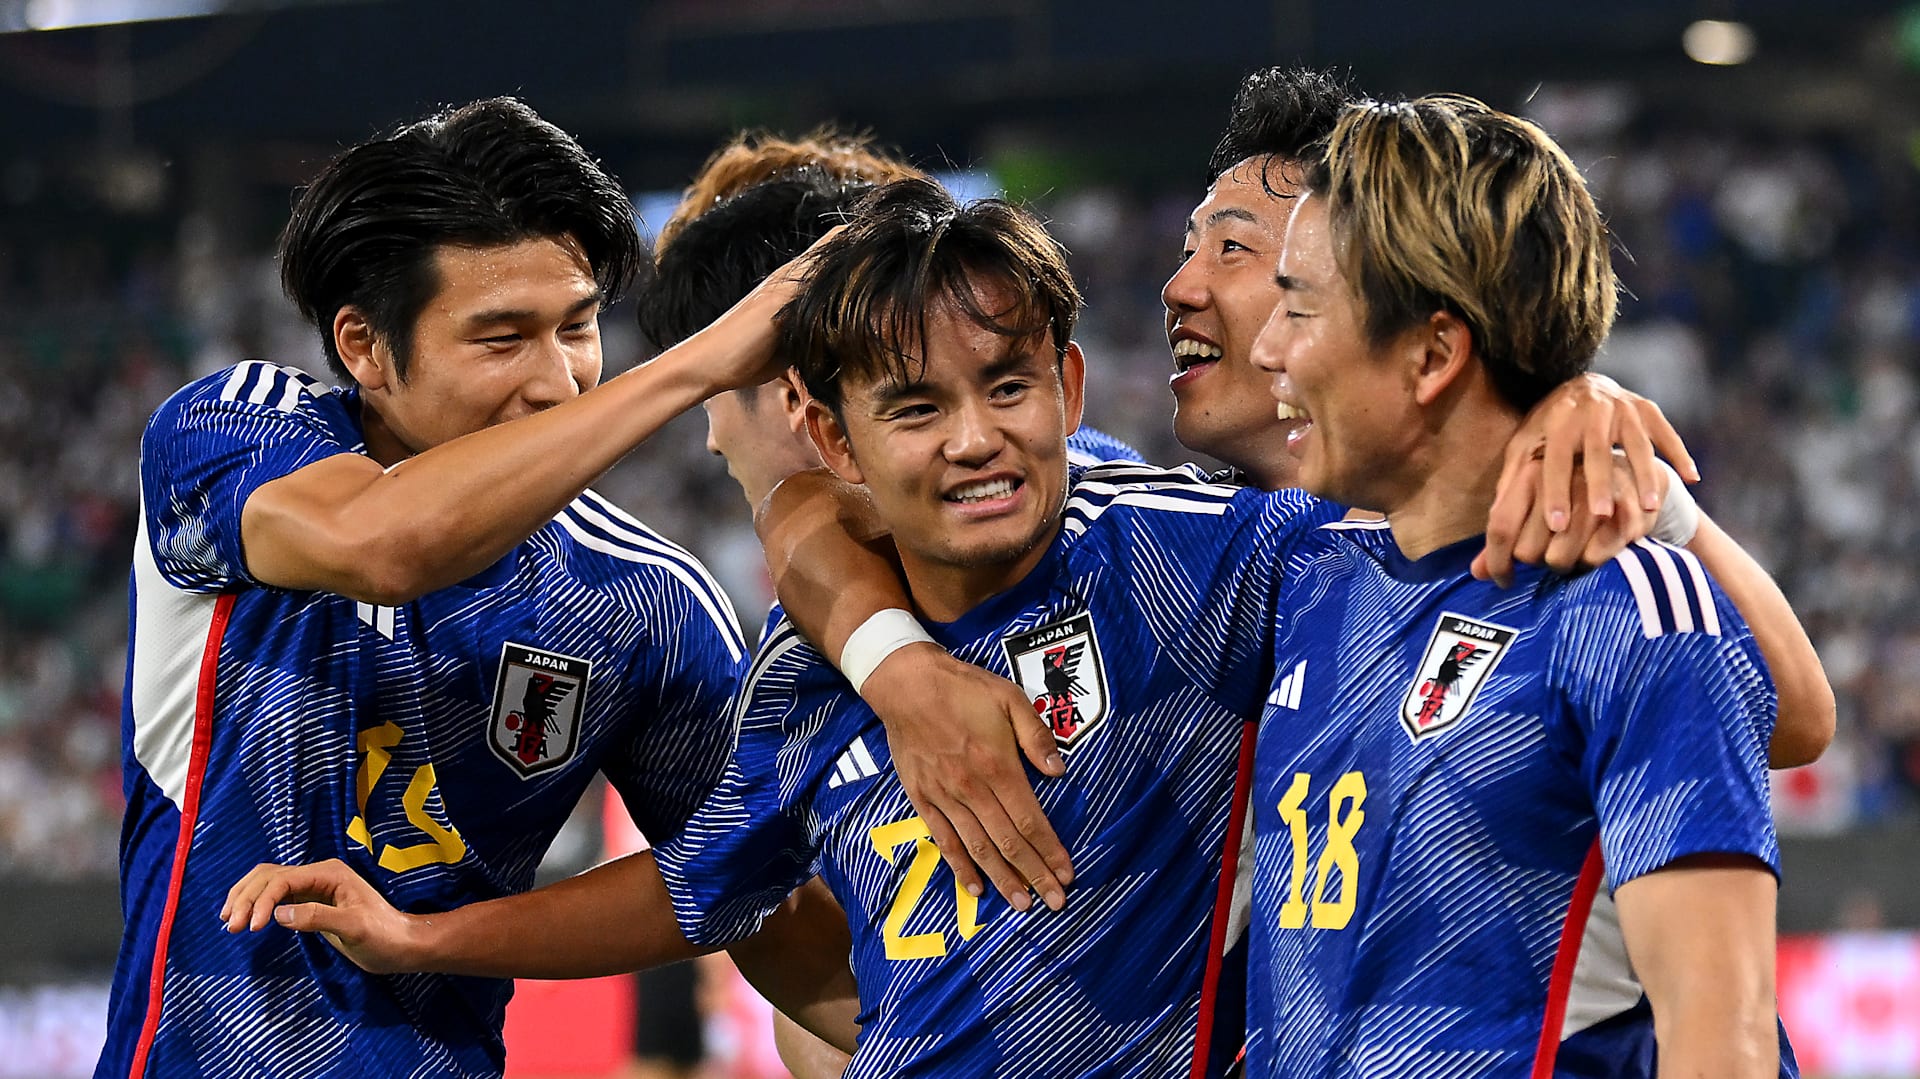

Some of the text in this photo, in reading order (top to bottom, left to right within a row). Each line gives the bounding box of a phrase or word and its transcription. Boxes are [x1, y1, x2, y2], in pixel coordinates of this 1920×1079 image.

[1028, 624, 1074, 647] JAPAN
[1453, 621, 1498, 640] JAPAN
[525, 653, 569, 671] JAPAN
[508, 733, 549, 758] JFA
[1277, 771, 1368, 930] 18
